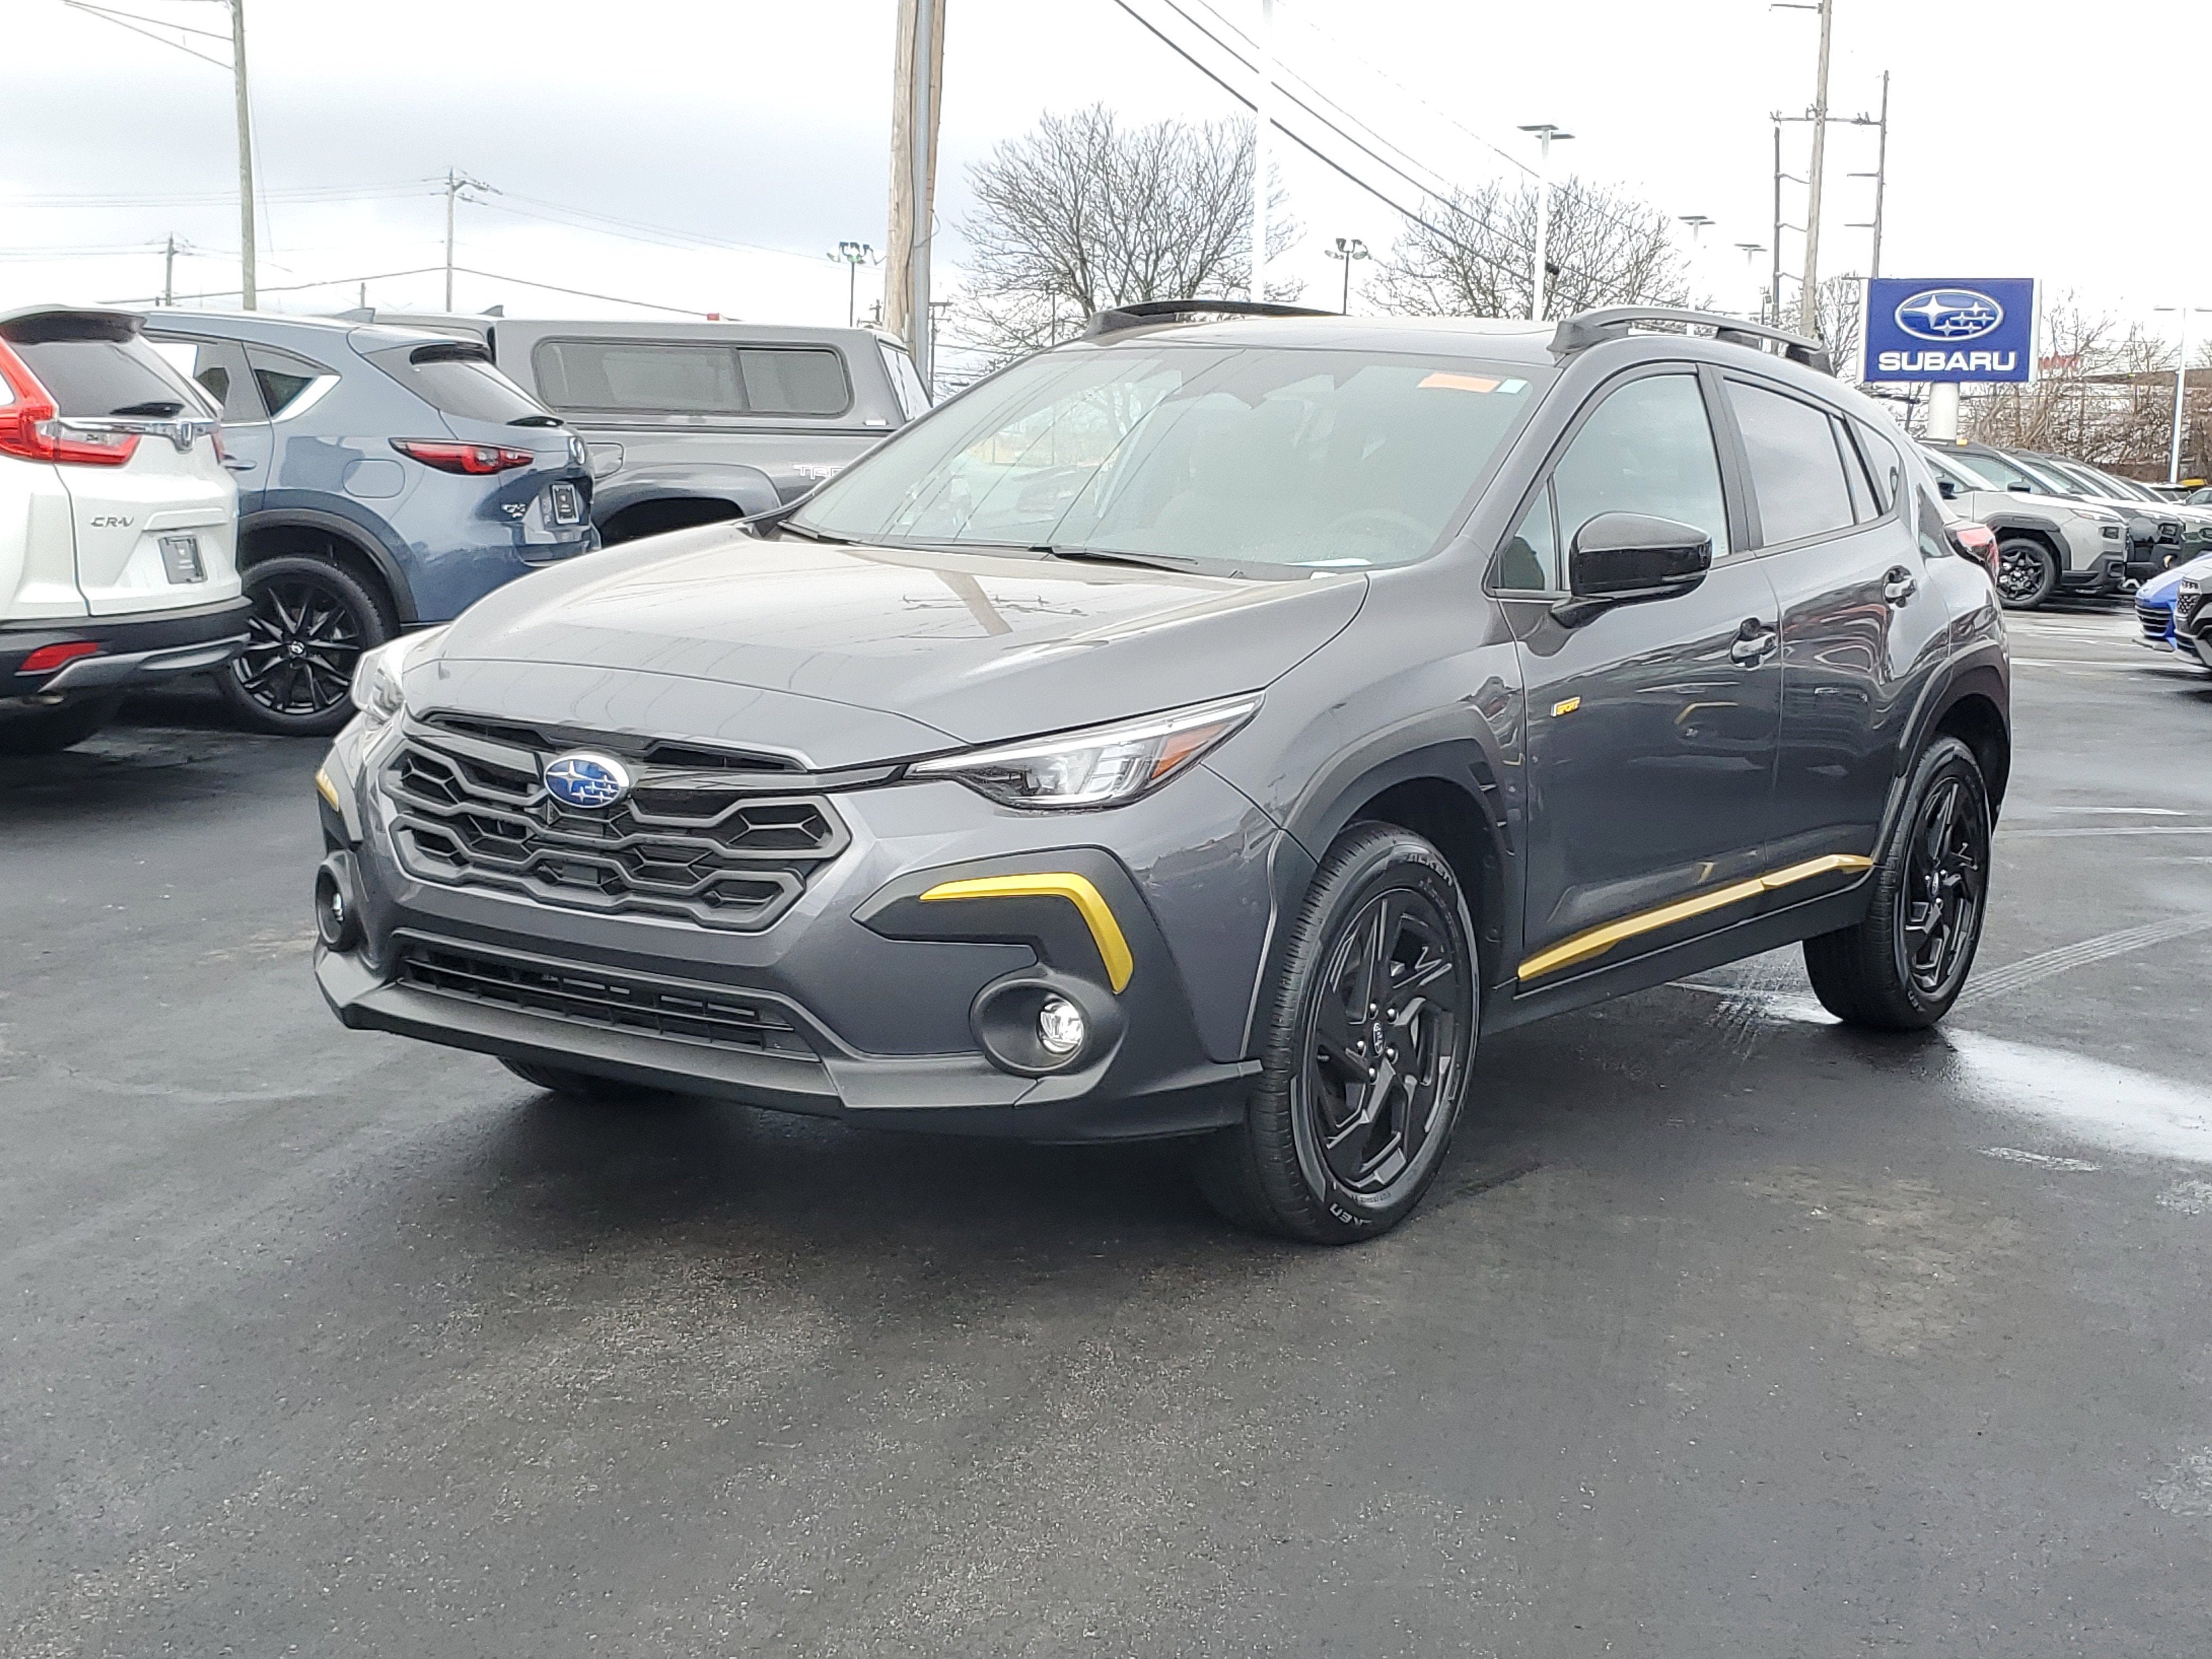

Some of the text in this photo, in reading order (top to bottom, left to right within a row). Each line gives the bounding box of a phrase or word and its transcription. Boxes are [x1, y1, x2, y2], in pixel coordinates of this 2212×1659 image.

[1878, 351, 2016, 371] SUBARU
[91, 517, 134, 527] CR-V
[1406, 853, 1453, 887] ALKEN
